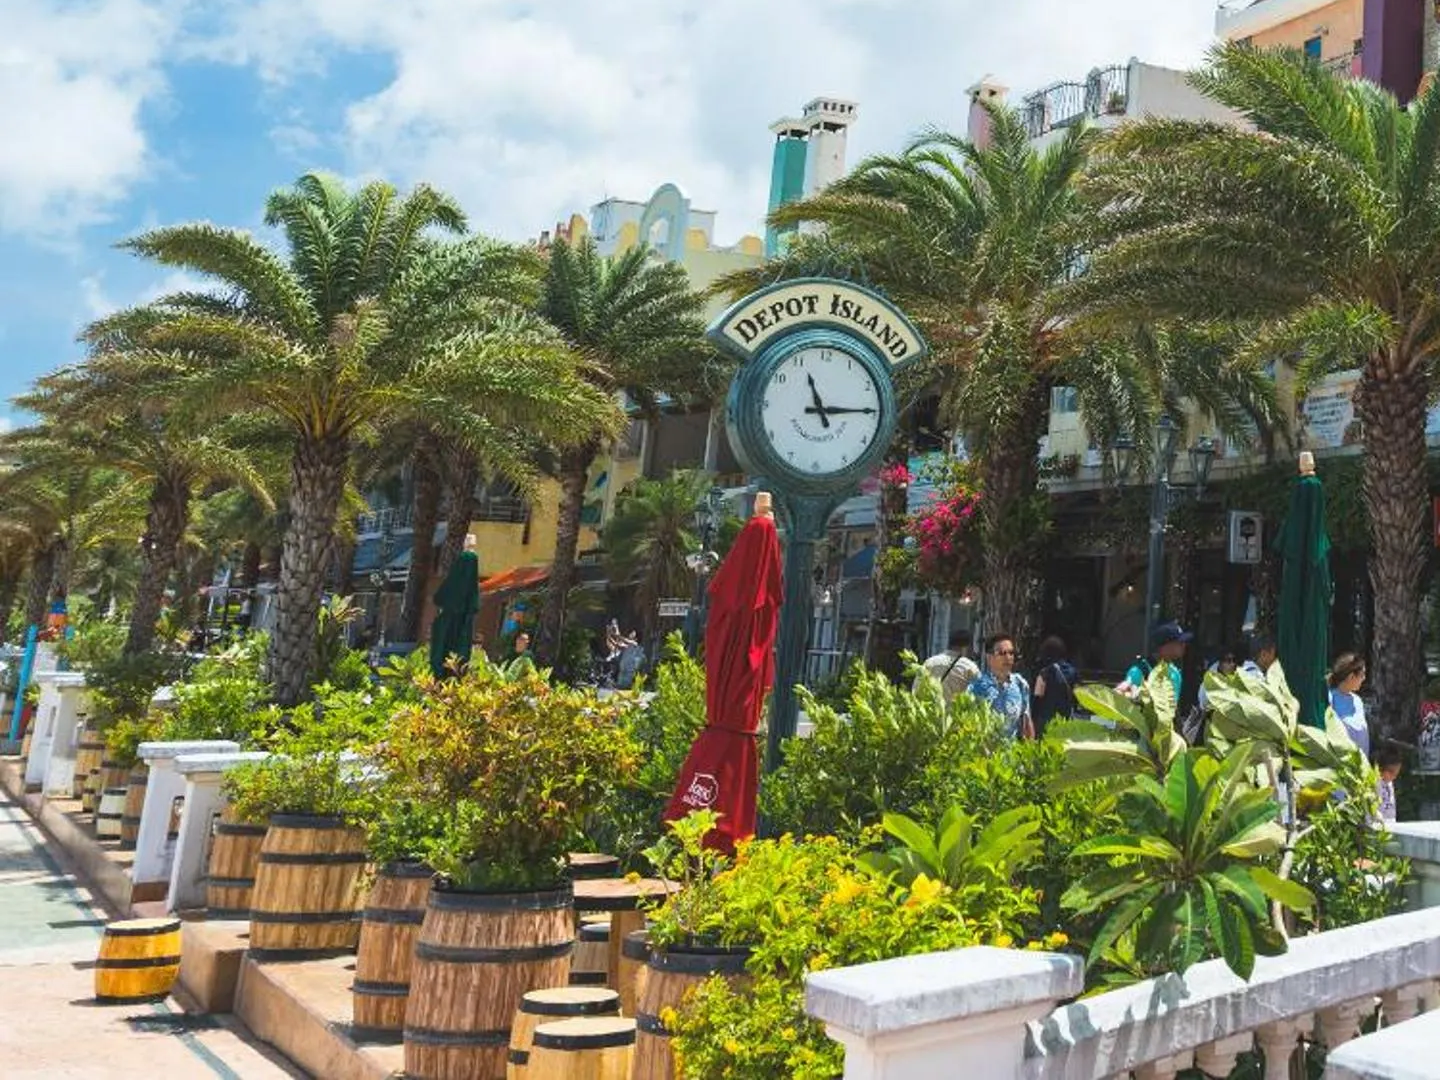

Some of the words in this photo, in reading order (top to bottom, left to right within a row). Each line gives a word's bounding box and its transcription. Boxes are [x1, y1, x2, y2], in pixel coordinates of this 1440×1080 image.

[734, 295, 819, 344] DEPOT
[828, 293, 908, 358] ISLAND
[794, 356, 804, 367] 11
[821, 350, 833, 362] 12
[775, 373, 787, 384] 10
